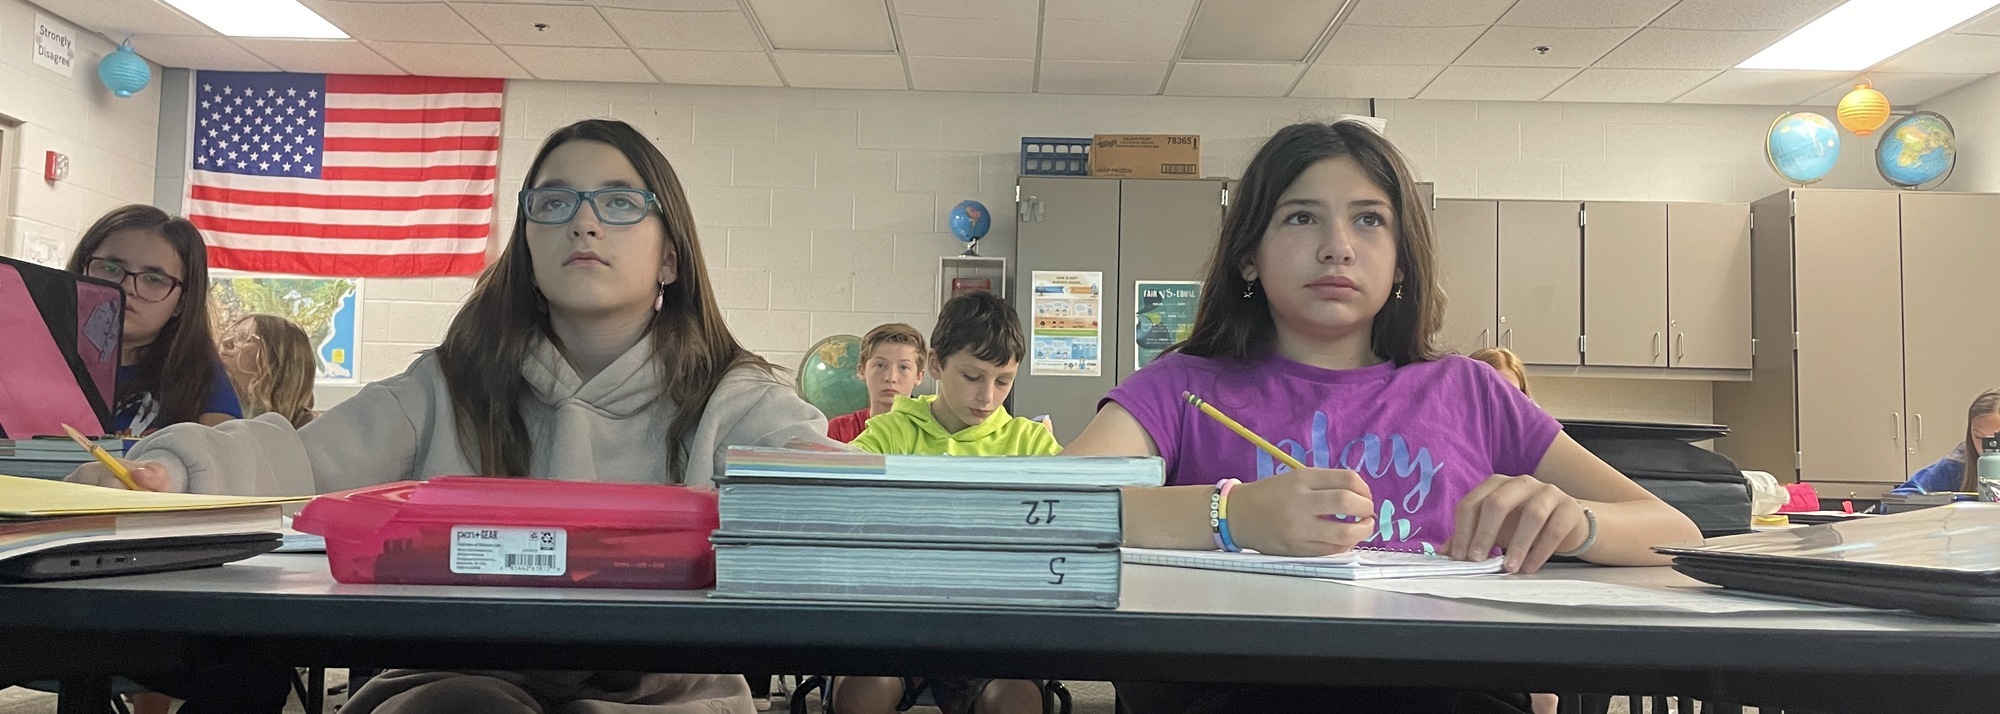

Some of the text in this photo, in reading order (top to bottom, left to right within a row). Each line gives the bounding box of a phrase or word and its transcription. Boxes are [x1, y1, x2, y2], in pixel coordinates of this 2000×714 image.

[40, 24, 71, 49] Strongly
[38, 44, 71, 67] Disagree
[1143, 288, 1195, 299] FAIR VS EQUAL
[1021, 500, 1060, 525] 12
[1048, 557, 1066, 585] 5
